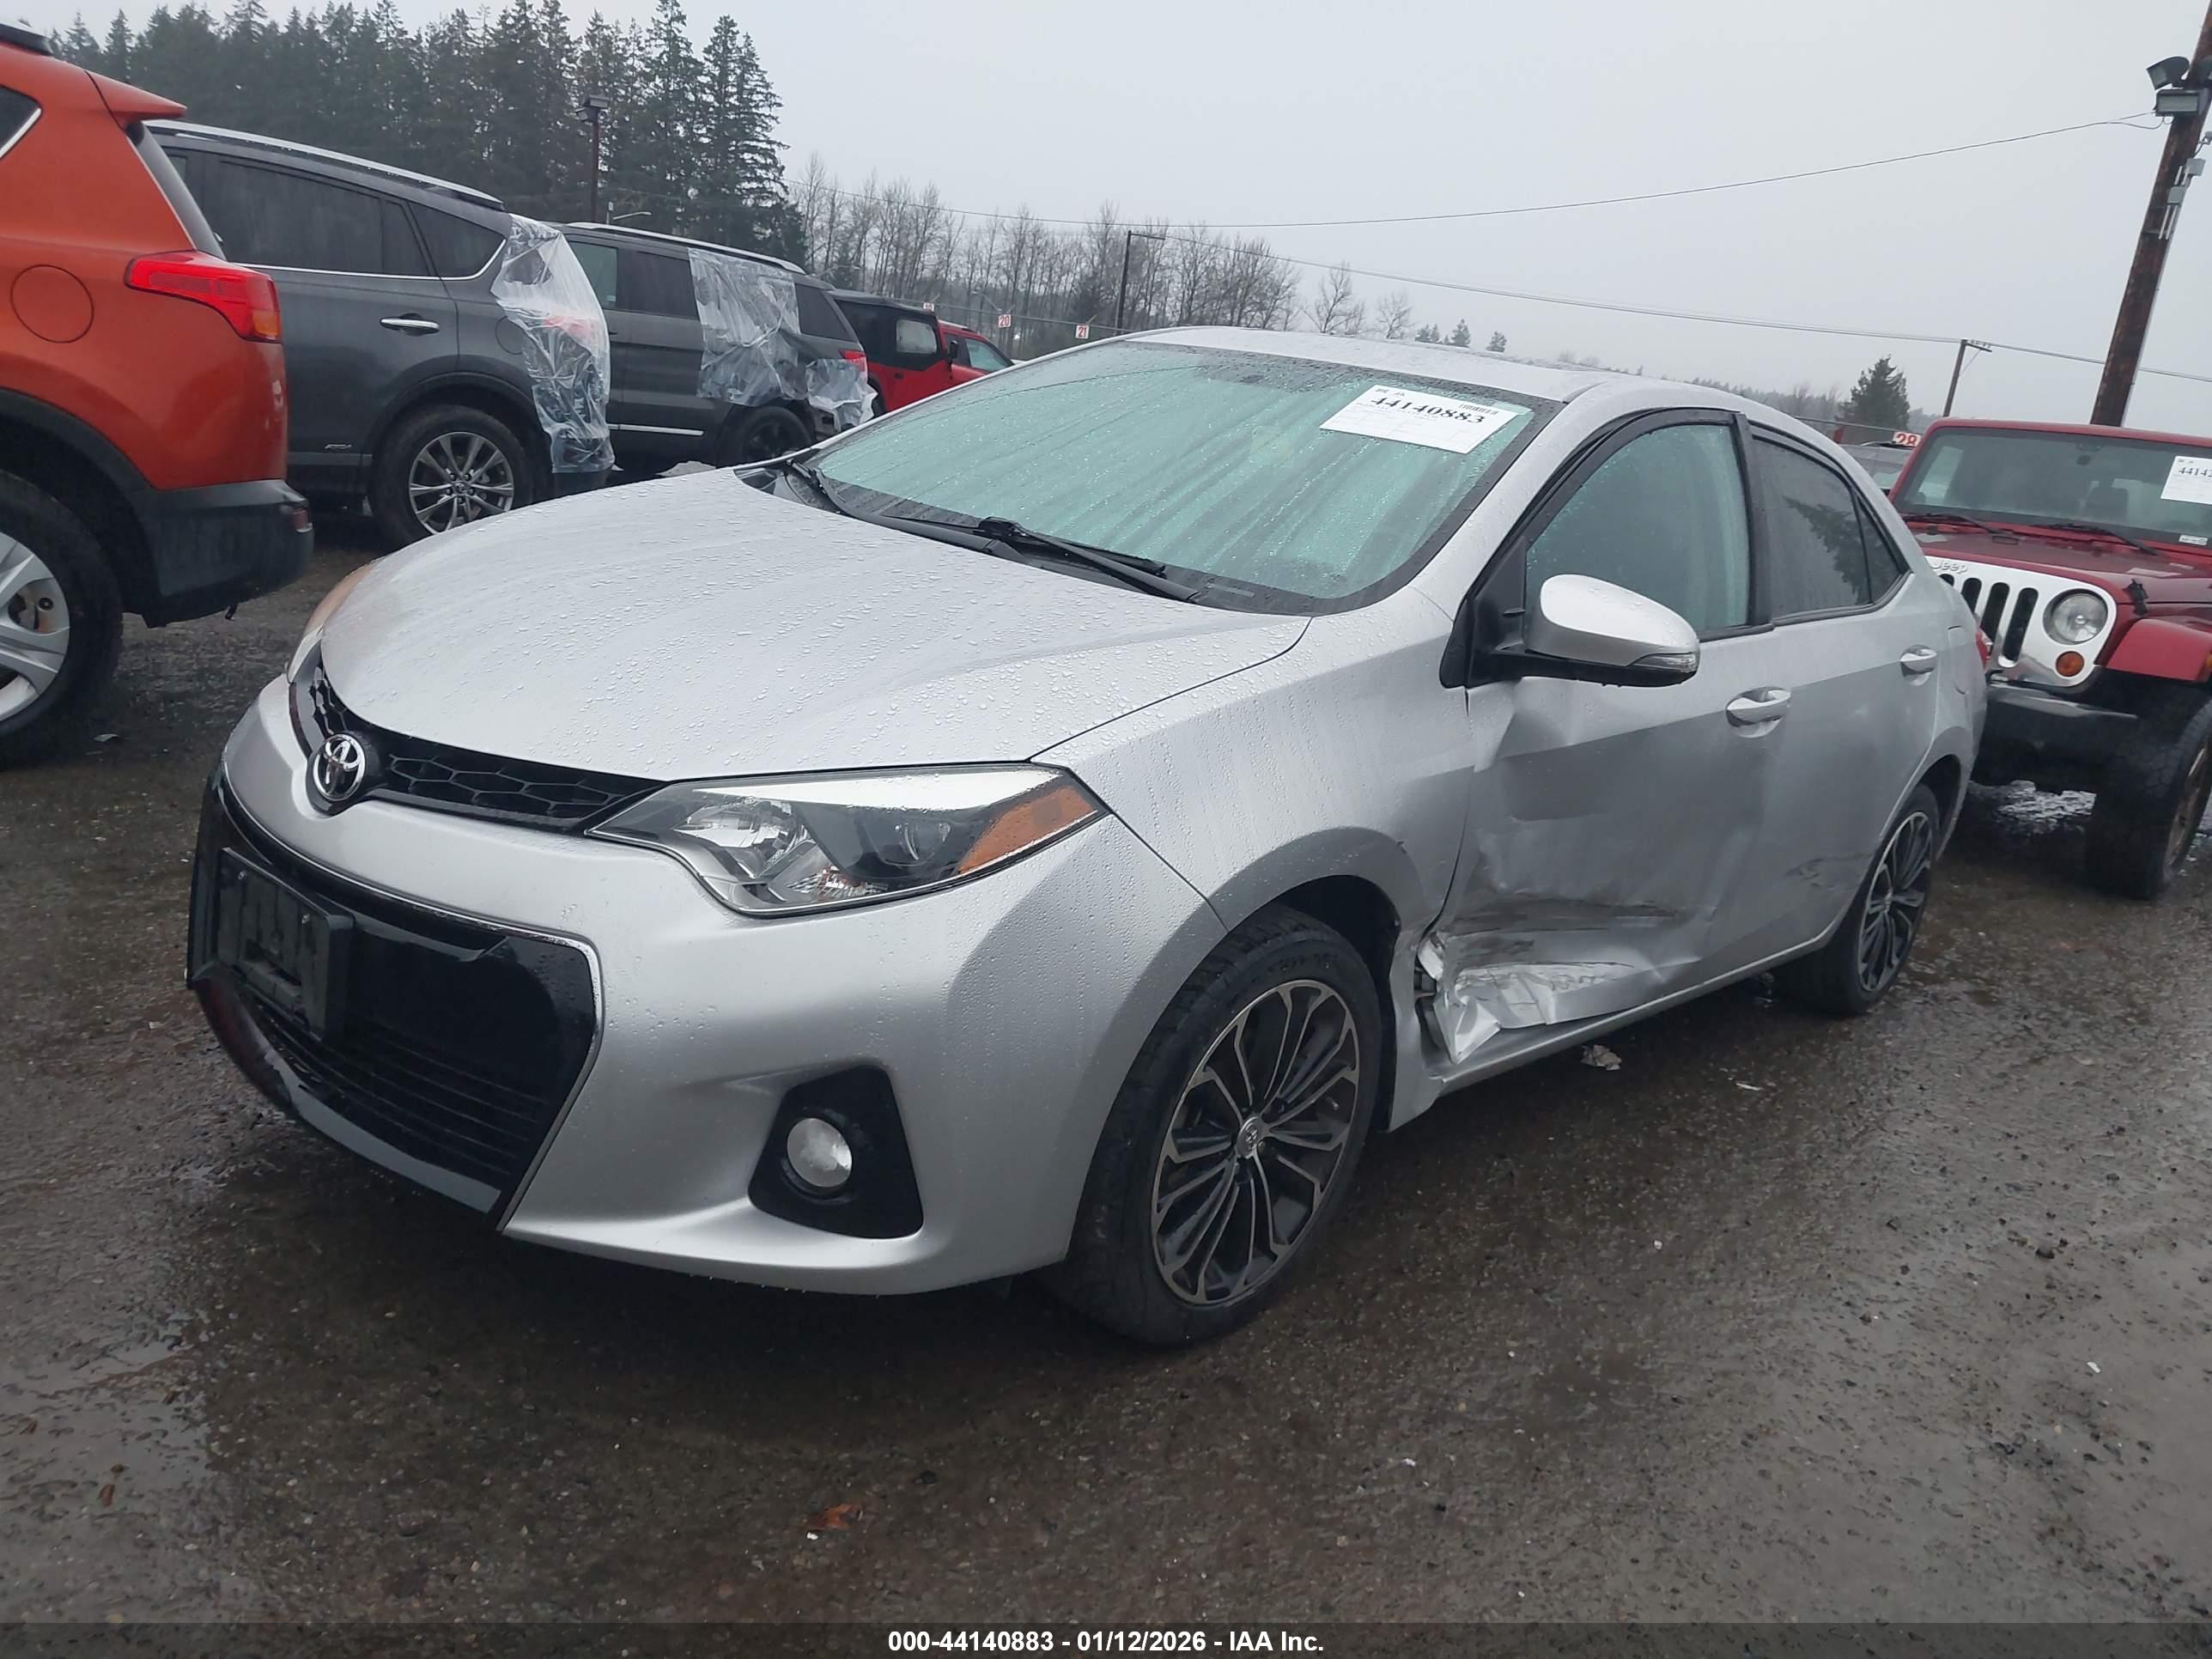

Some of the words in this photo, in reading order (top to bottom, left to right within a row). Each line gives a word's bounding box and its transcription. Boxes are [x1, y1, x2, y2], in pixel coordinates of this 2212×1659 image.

[999, 315, 1010, 326] 20
[1078, 326, 1087, 337] 21
[1370, 397, 1486, 423] 44140883
[1896, 433, 1917, 446] 28
[1929, 559, 1968, 574] Jeep
